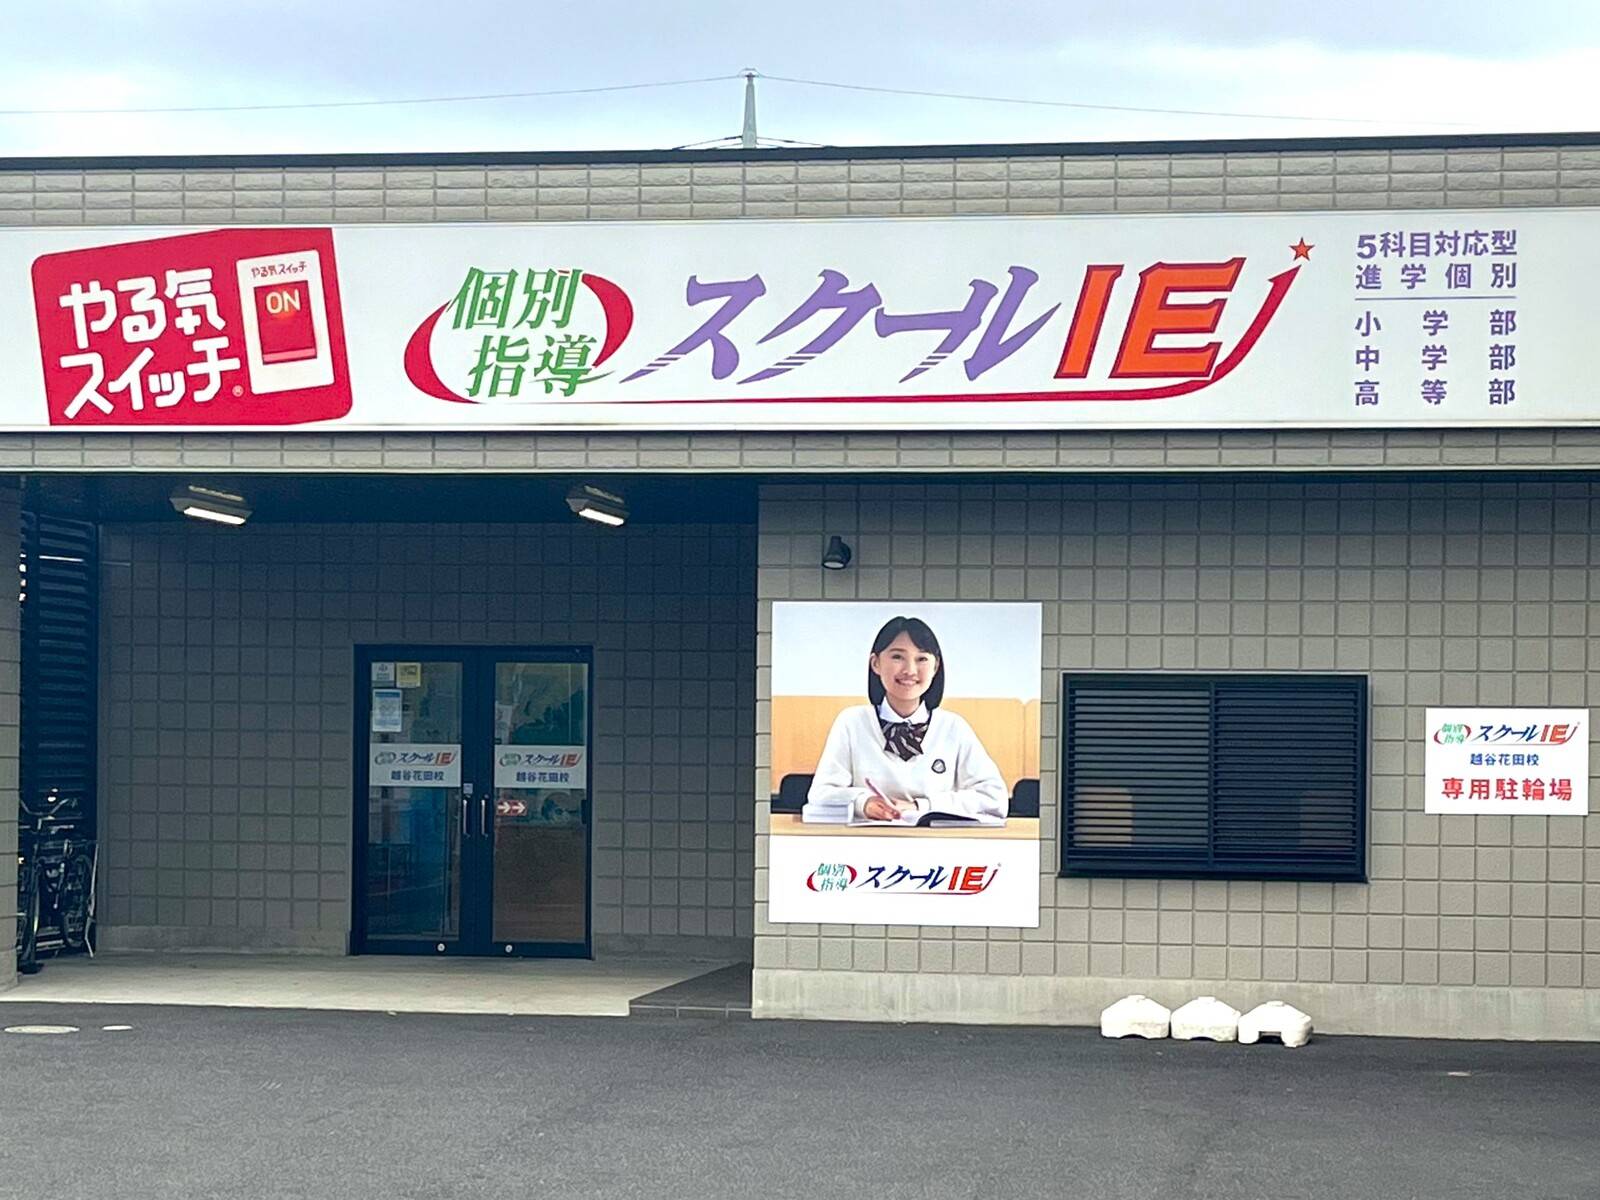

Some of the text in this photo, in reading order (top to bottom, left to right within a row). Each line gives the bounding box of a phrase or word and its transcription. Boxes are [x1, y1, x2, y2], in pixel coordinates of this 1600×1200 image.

[1357, 230, 1517, 259] 5科目対応型
[1356, 262, 1517, 290] 進学個別
[59, 267, 226, 349] やる気
[266, 289, 301, 314] ON
[450, 266, 582, 331] 個別
[59, 337, 242, 420] スイッチ
[468, 334, 597, 399] 指導
[1469, 753, 1540, 766] 越谷花田校
[1441, 777, 1573, 801] 専用駐輪場
